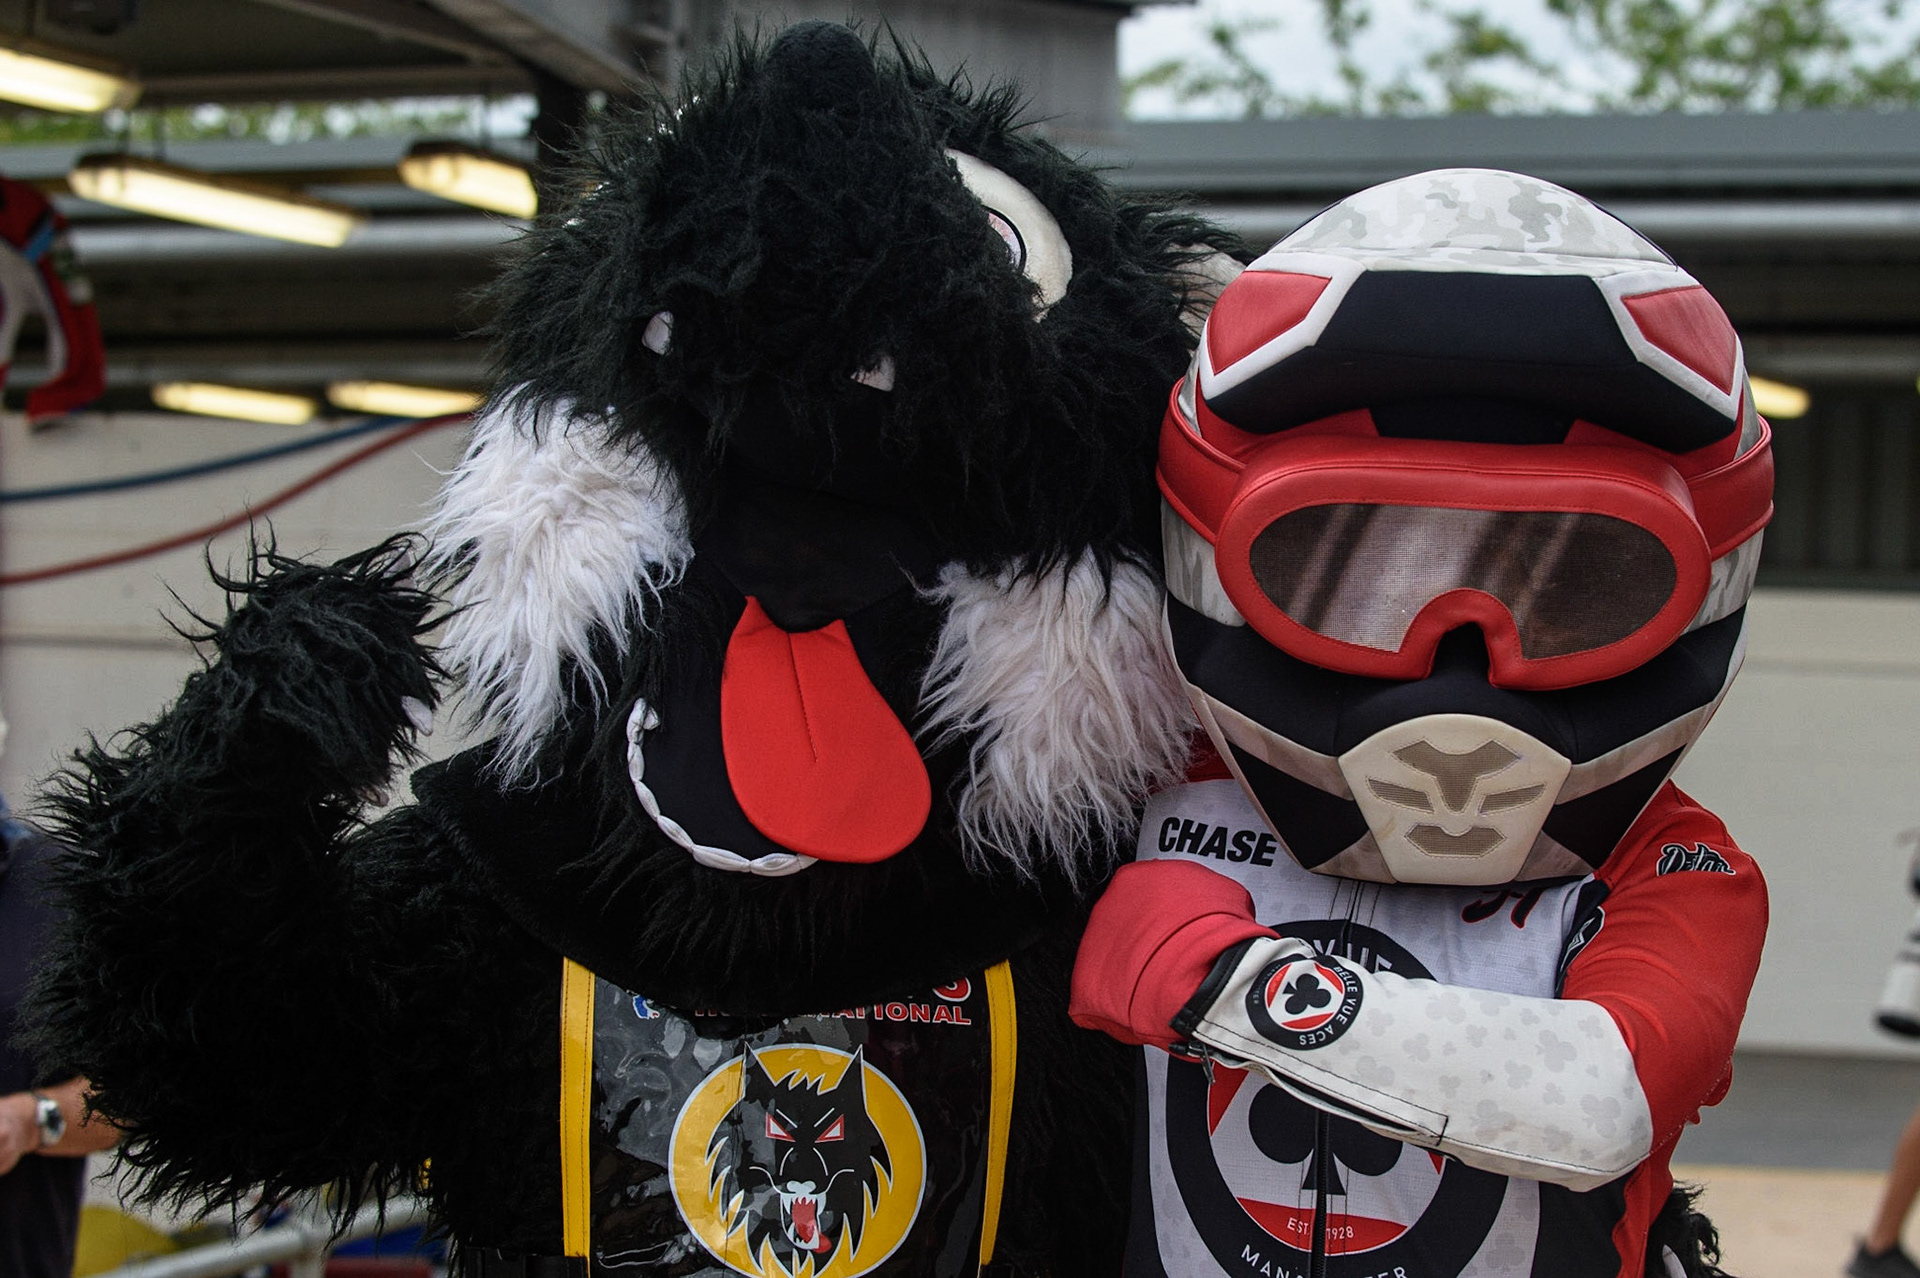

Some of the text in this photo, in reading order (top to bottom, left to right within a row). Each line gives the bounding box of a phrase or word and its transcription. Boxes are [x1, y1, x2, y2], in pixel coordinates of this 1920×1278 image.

[1158, 817, 1278, 867] CHASE
[1299, 966, 1358, 1046] BELLE VUE ACES
[1326, 1225, 1354, 1240] 1928
